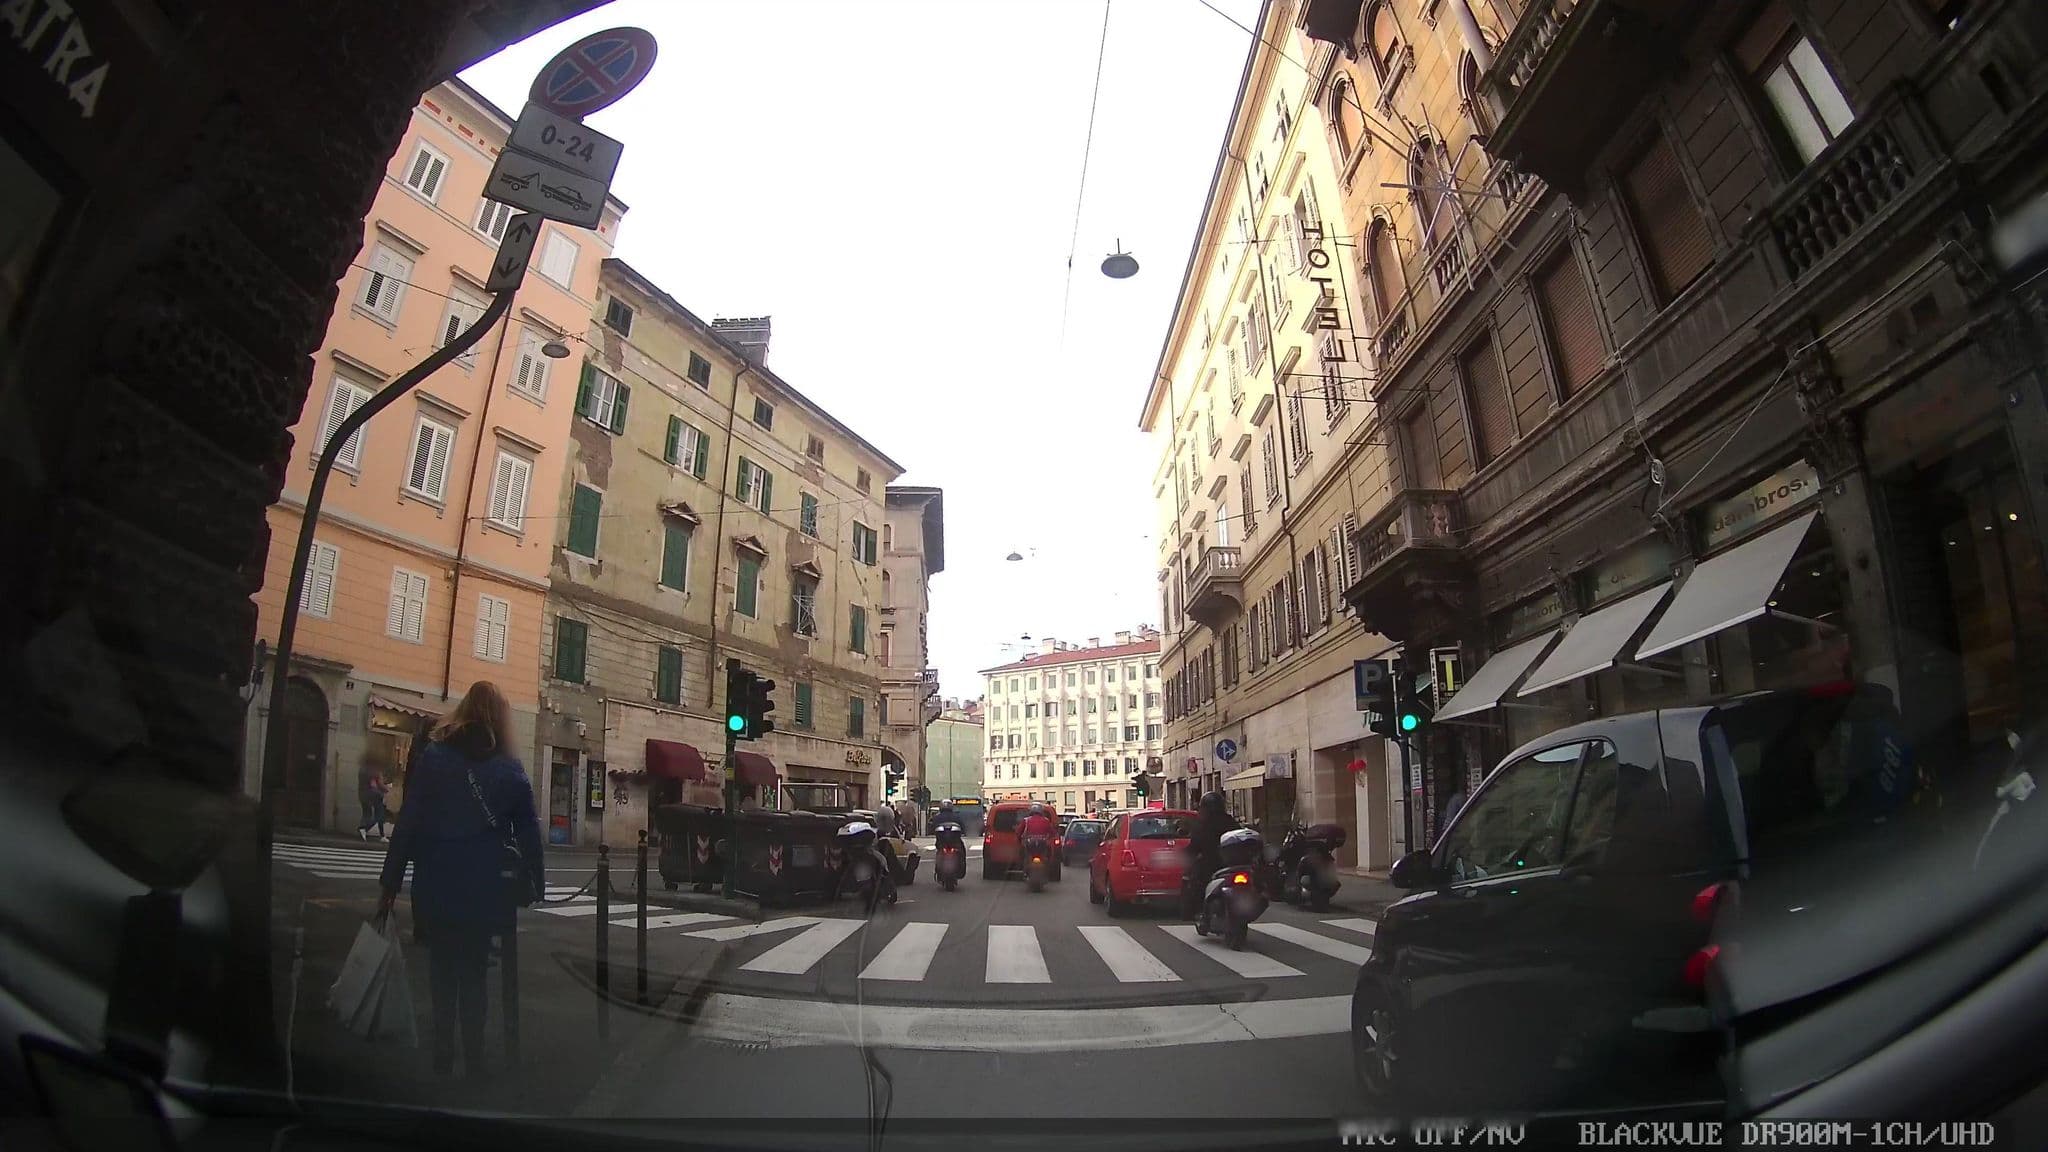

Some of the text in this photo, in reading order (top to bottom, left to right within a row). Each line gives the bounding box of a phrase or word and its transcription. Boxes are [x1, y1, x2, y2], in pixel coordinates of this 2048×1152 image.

[541, 125, 595, 162] 0-24
[1301, 219, 1346, 362] HOTEL
[1360, 663, 1382, 694] P
